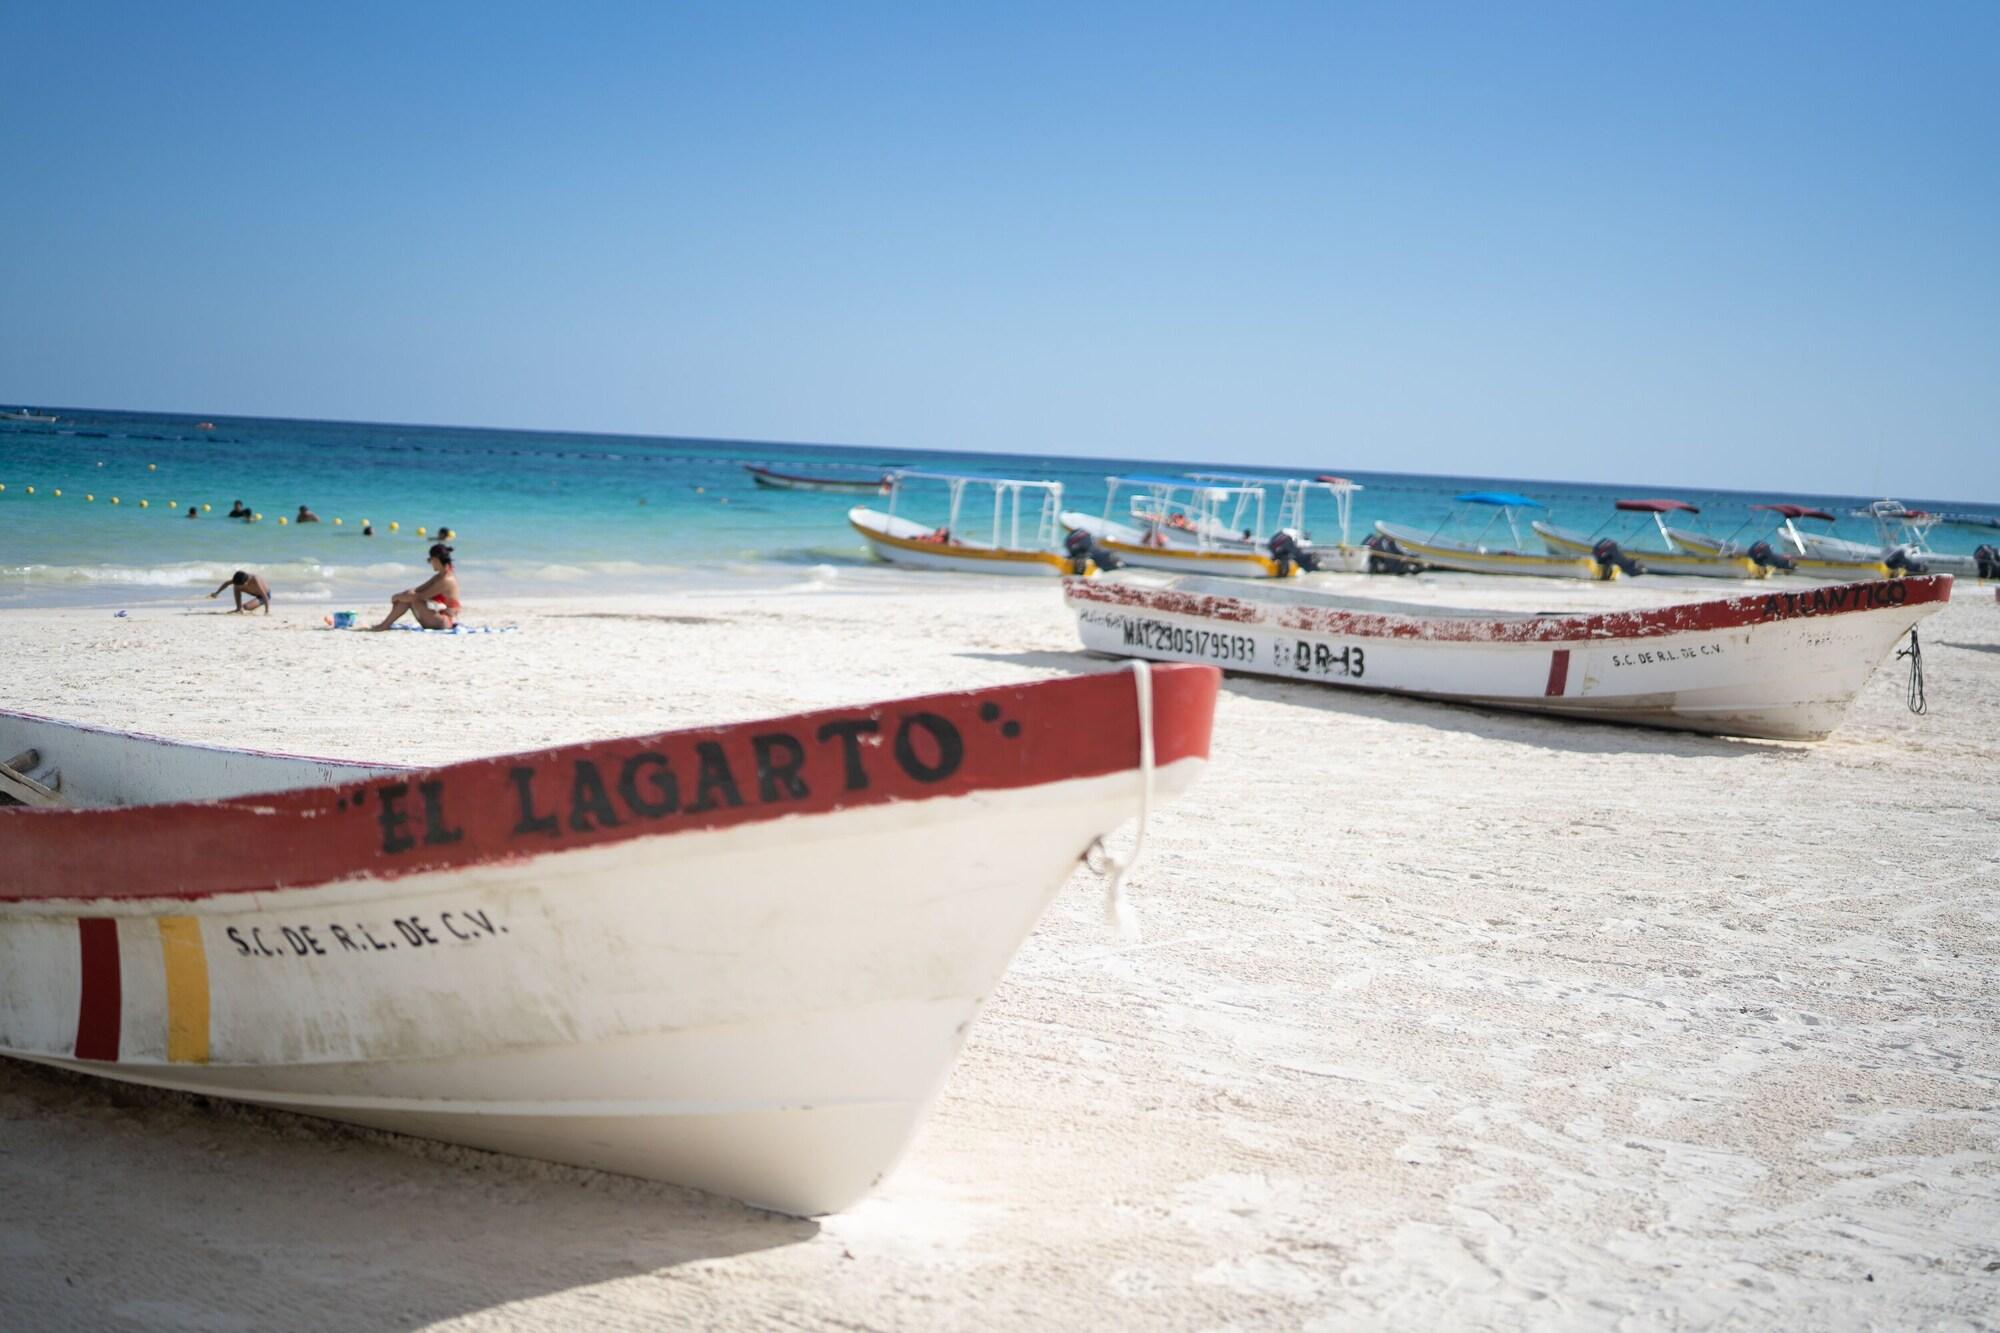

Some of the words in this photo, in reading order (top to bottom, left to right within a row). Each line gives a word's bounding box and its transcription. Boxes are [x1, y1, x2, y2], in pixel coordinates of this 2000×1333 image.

[1763, 579, 1907, 621] ATLANTICO
[1612, 654, 1636, 667] S.C.
[1637, 651, 1655, 664] DE
[1656, 650, 1679, 662] R.L.
[1680, 647, 1697, 659] DE
[1700, 643, 1725, 656] C.V.
[226, 926, 283, 957] S.C.
[281, 925, 327, 957] DE
[329, 923, 397, 952] R.L.
[393, 916, 439, 948] DE
[440, 909, 510, 942] C.V.
